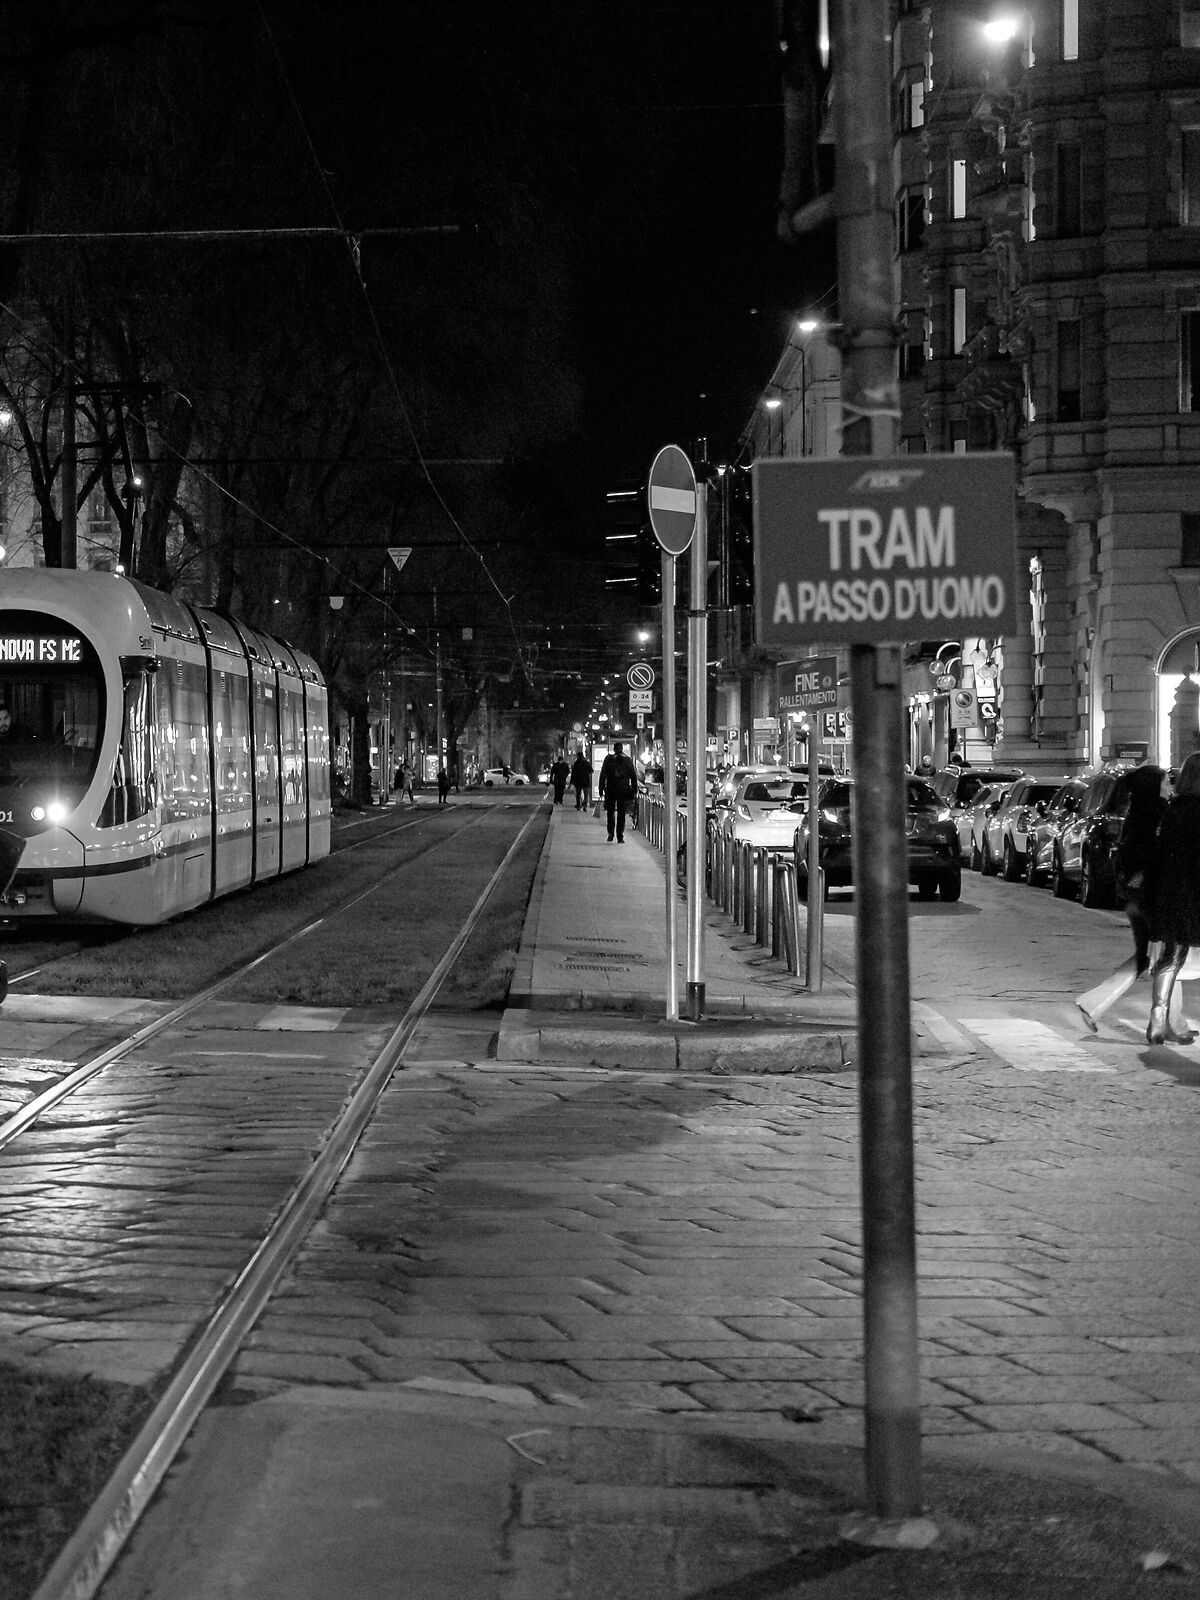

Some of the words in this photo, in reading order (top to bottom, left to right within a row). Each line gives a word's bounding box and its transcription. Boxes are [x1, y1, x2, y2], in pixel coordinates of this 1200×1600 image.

[817, 506, 956, 571] TRAM
[772, 580, 795, 624] A
[797, 579, 891, 623] PASSO
[894, 575, 1004, 620] D'UOMO
[39, 639, 57, 661] FS
[61, 639, 81, 661] M2
[795, 672, 820, 692] FINE
[779, 689, 837, 709] RALLENTAMENTO
[729, 730, 737, 740] P
